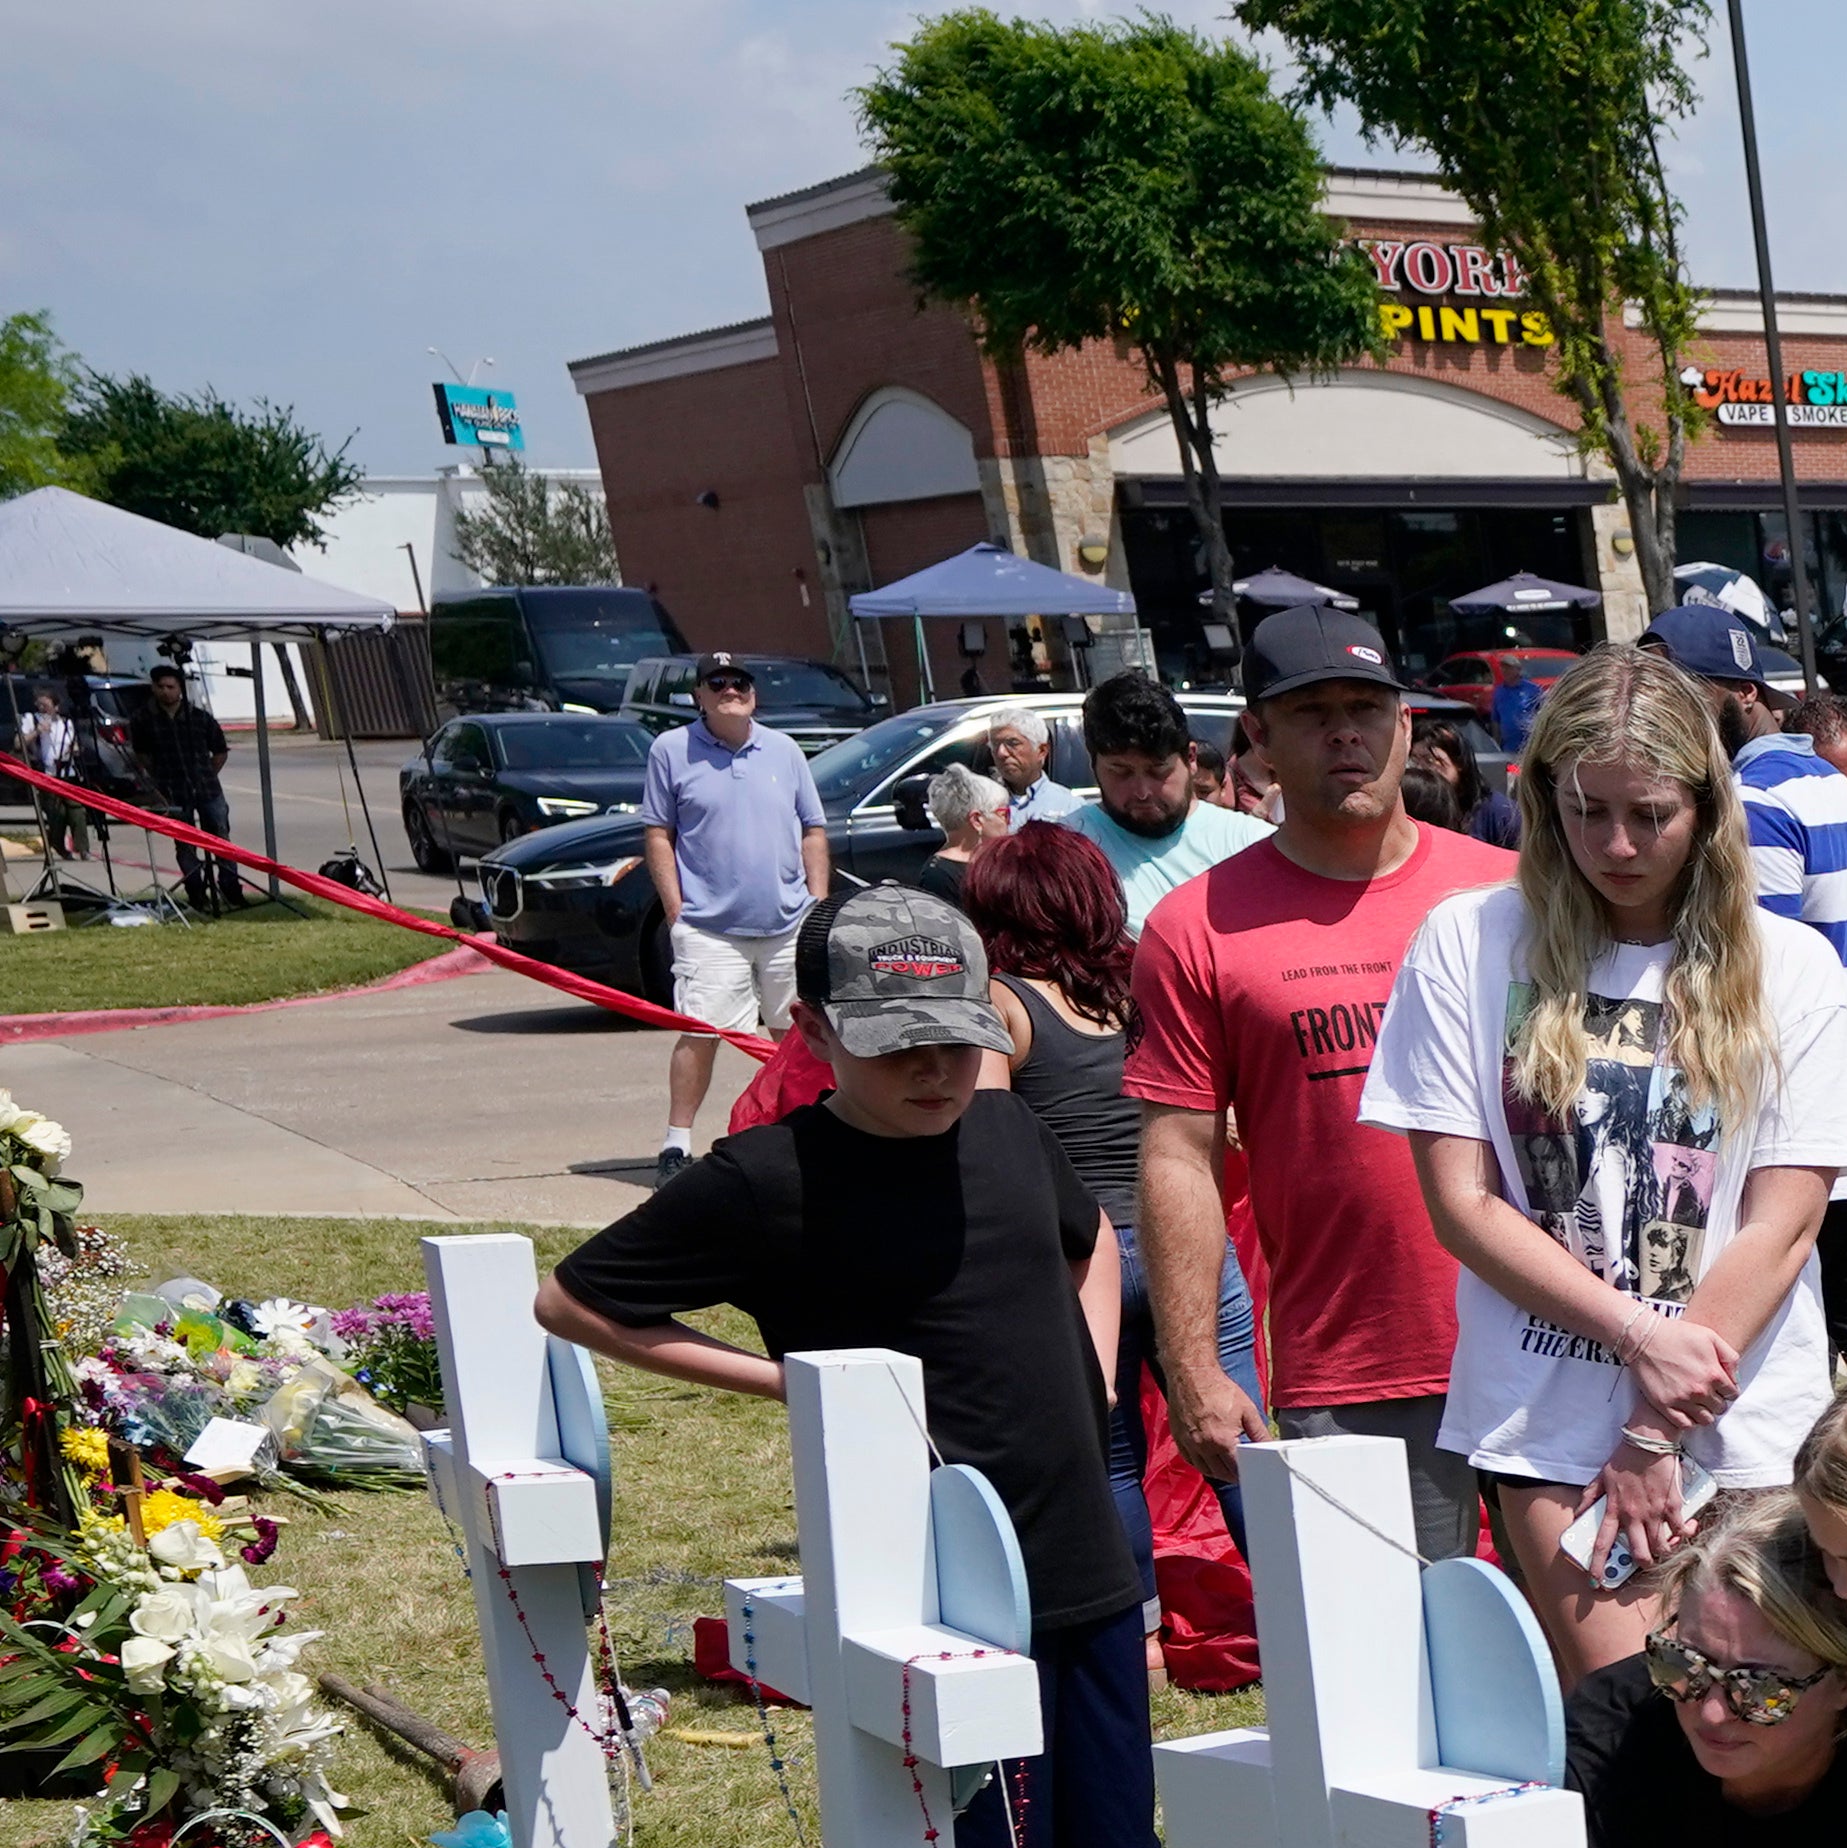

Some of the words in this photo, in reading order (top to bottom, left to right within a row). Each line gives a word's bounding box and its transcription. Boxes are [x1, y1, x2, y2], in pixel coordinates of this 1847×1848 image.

[1693, 367, 1800, 410] Hazl
[1726, 405, 1769, 422] VAPE
[875, 961, 961, 977] POWER
[1281, 968, 1308, 981] LEAD
[1309, 965, 1339, 978] FROM
[1340, 963, 1360, 975] THE
[1361, 961, 1393, 974] FRONT
[1520, 1328, 1569, 1359] THE
